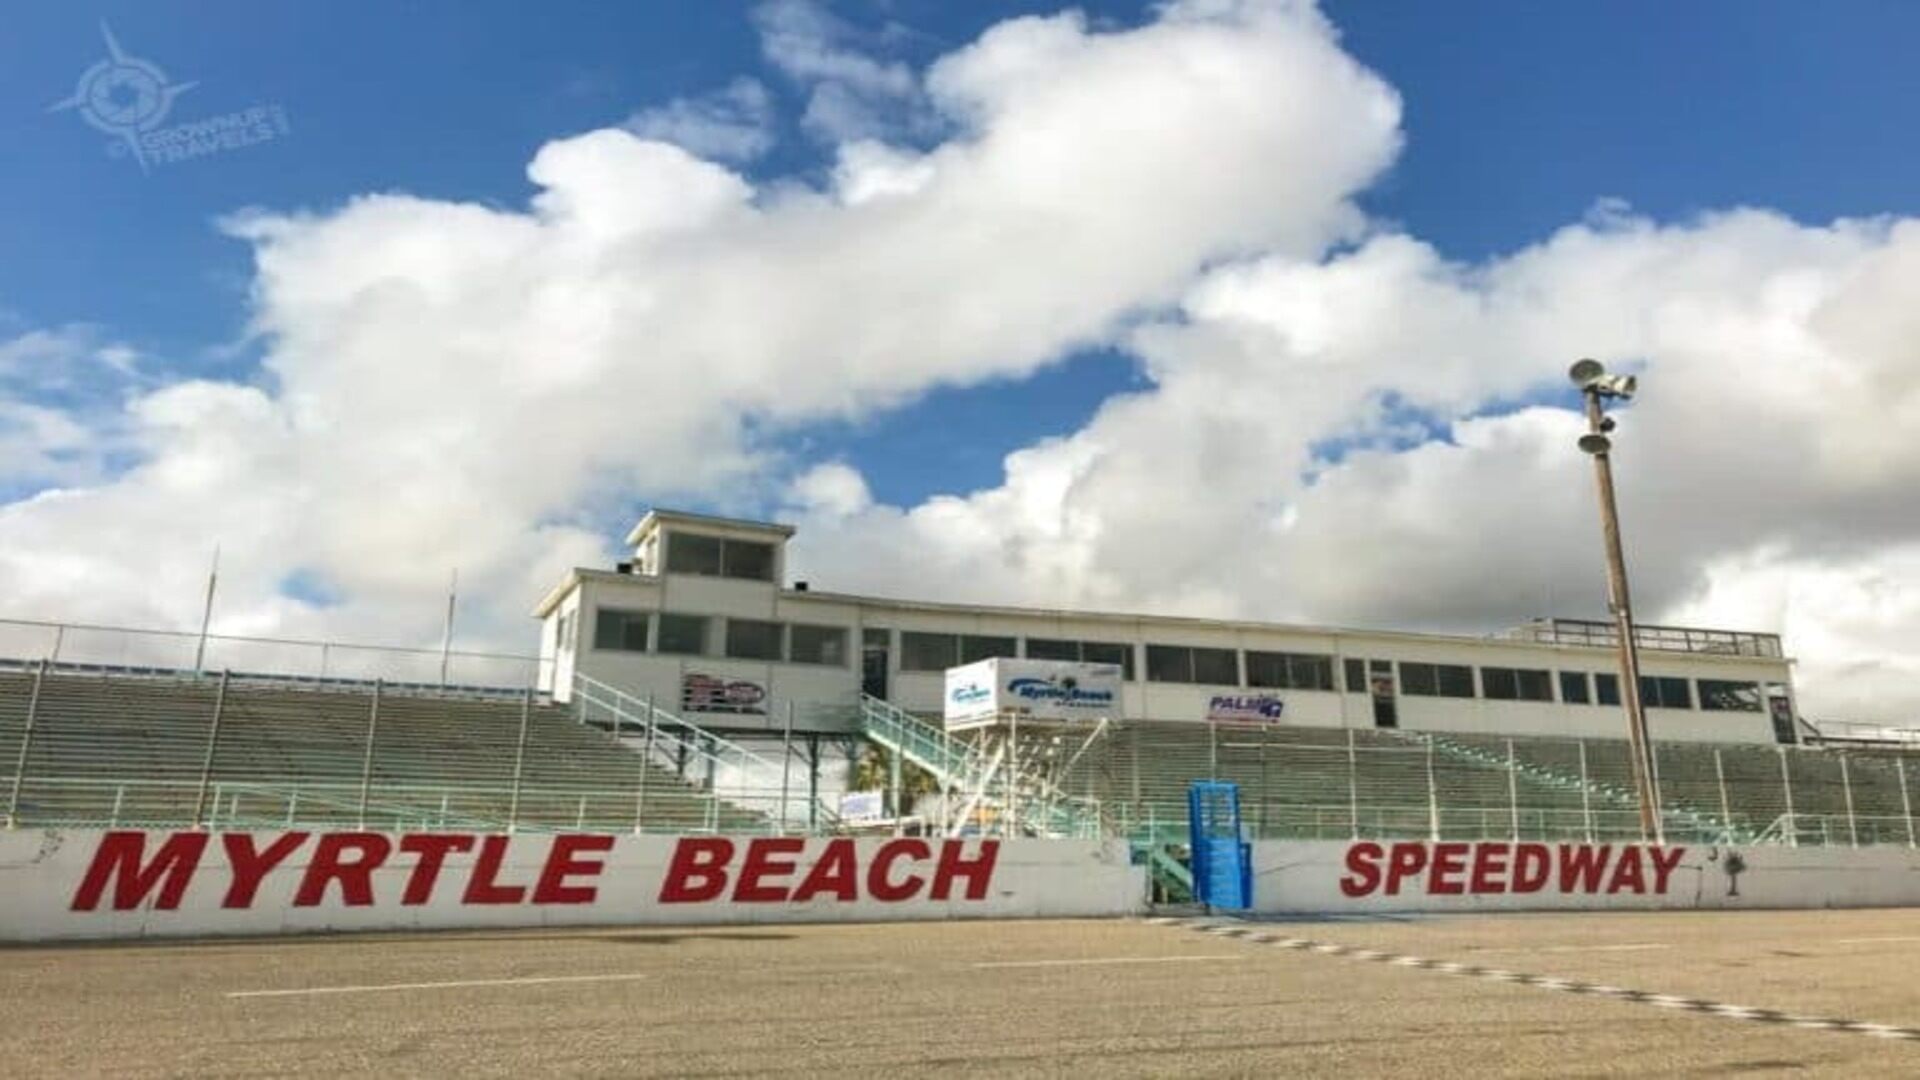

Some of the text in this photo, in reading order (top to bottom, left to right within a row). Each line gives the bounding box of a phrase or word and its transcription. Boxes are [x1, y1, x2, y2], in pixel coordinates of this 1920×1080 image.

[71, 831, 1000, 911] MYRTLE BEACH
[1340, 841, 1686, 898] SPEEDWAY
